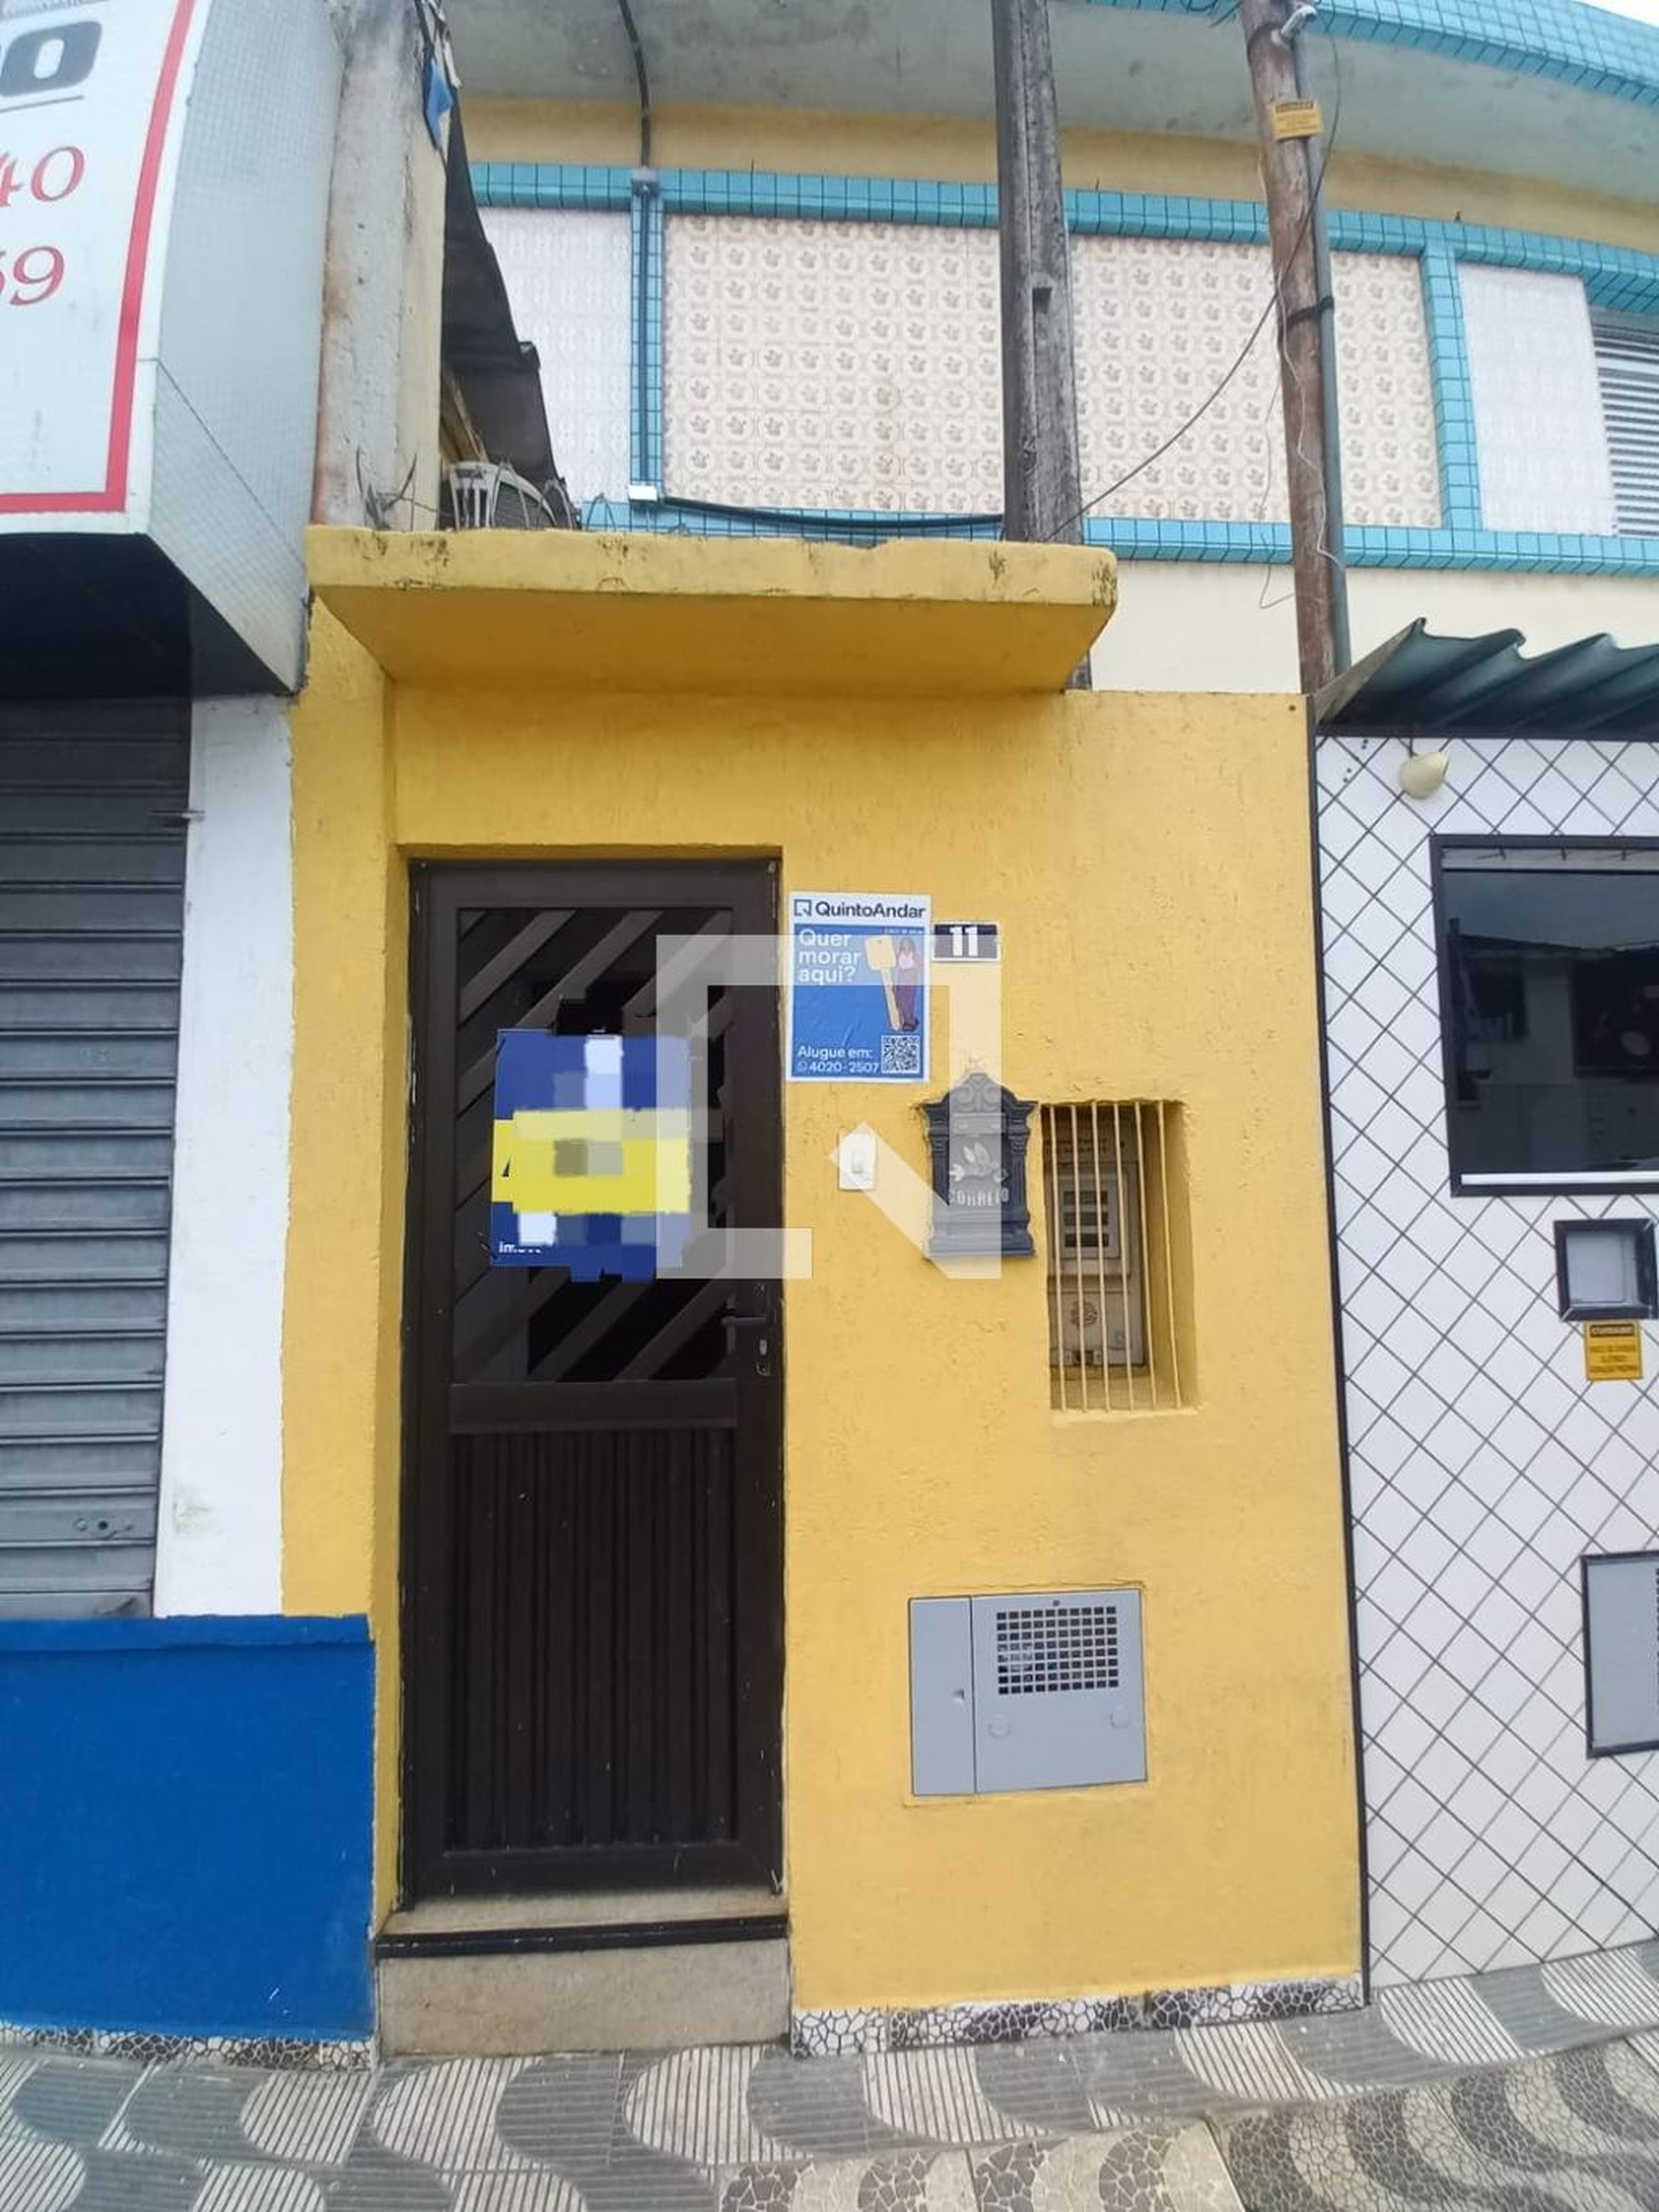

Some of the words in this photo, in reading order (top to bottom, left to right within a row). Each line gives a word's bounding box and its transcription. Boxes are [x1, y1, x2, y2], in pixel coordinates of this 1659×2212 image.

[815, 901, 925, 918] QuintoAndar
[800, 929, 852, 946] Quer
[949, 926, 978, 956] 11
[799, 950, 861, 964] morar
[799, 966, 856, 985] aqui?
[798, 1045, 845, 1060] Alugue
[848, 1047, 873, 1058] em:
